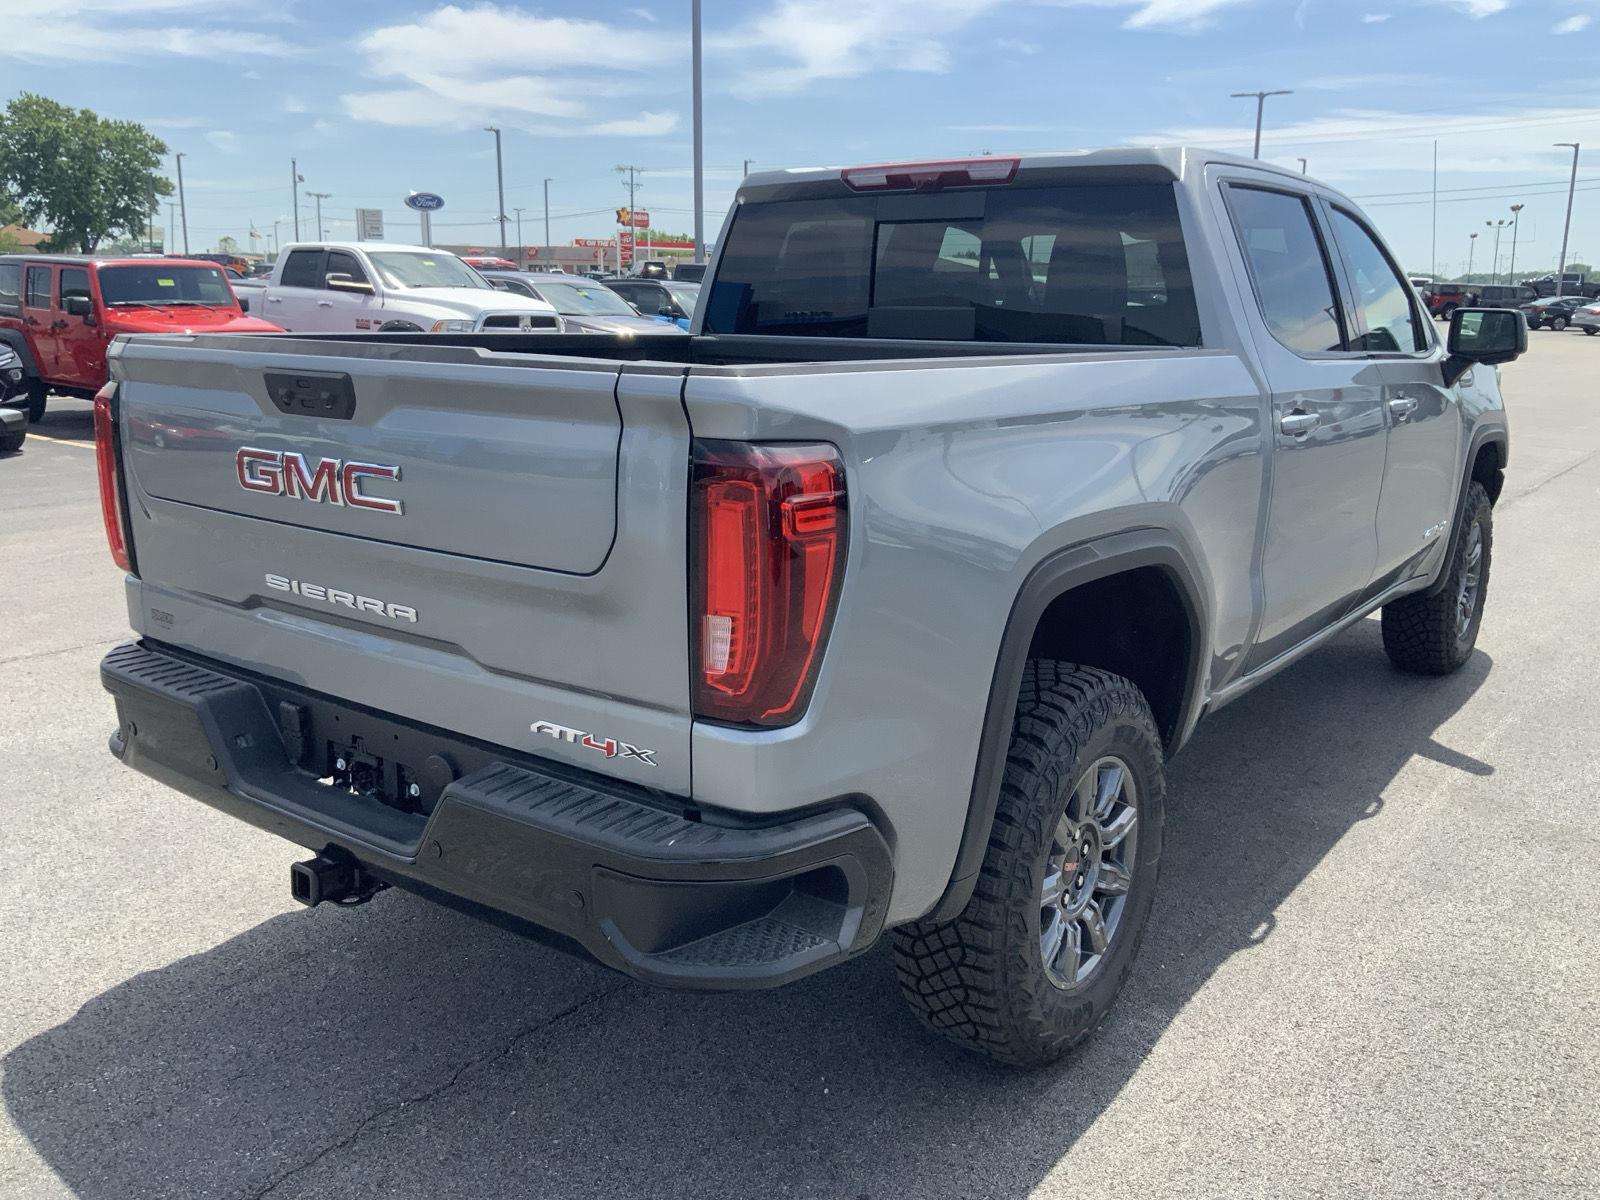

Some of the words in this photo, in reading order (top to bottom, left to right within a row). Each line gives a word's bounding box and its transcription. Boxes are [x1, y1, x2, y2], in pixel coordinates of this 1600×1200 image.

[416, 196, 437, 208] Ford
[236, 446, 403, 515] GMC
[265, 573, 418, 622] SIERRA
[530, 720, 658, 766] AT4X
